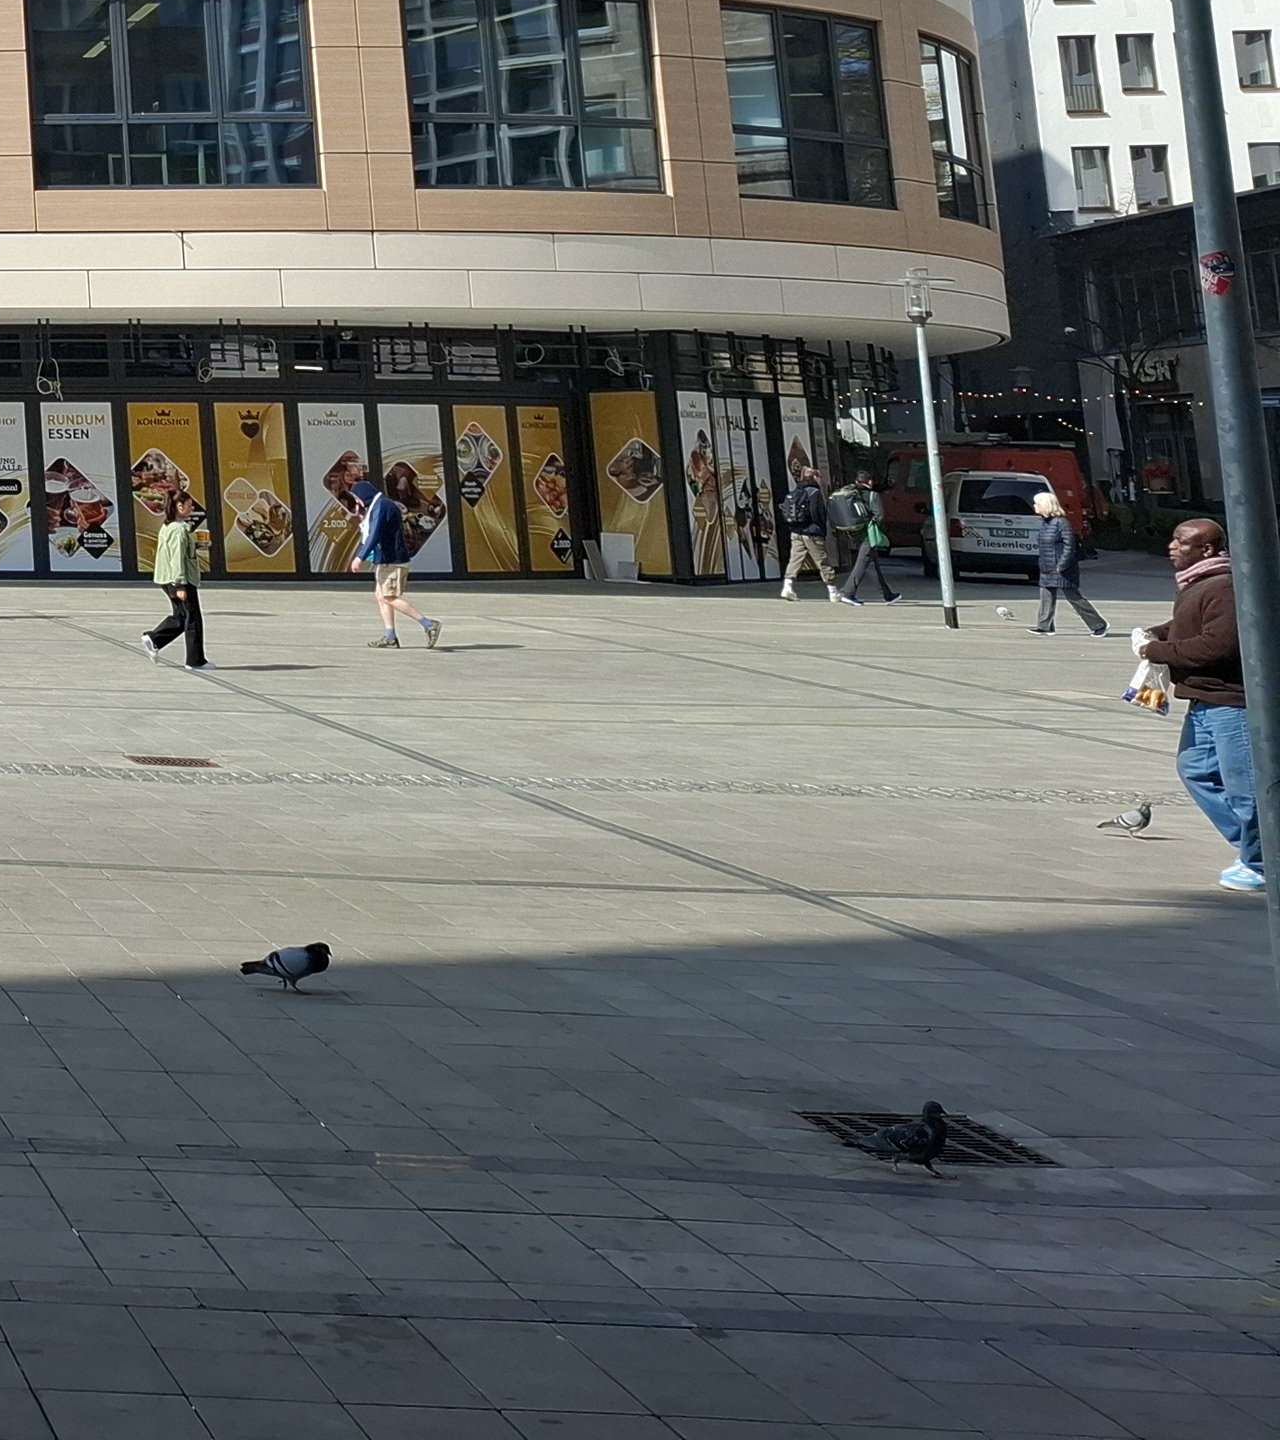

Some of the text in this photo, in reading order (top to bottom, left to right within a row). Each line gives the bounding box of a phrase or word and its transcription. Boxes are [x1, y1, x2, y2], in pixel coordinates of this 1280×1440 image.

[47, 414, 105, 426] RUNDUM
[48, 428, 89, 439] ESSEN
[976, 539, 1040, 551] Fliesenlege
